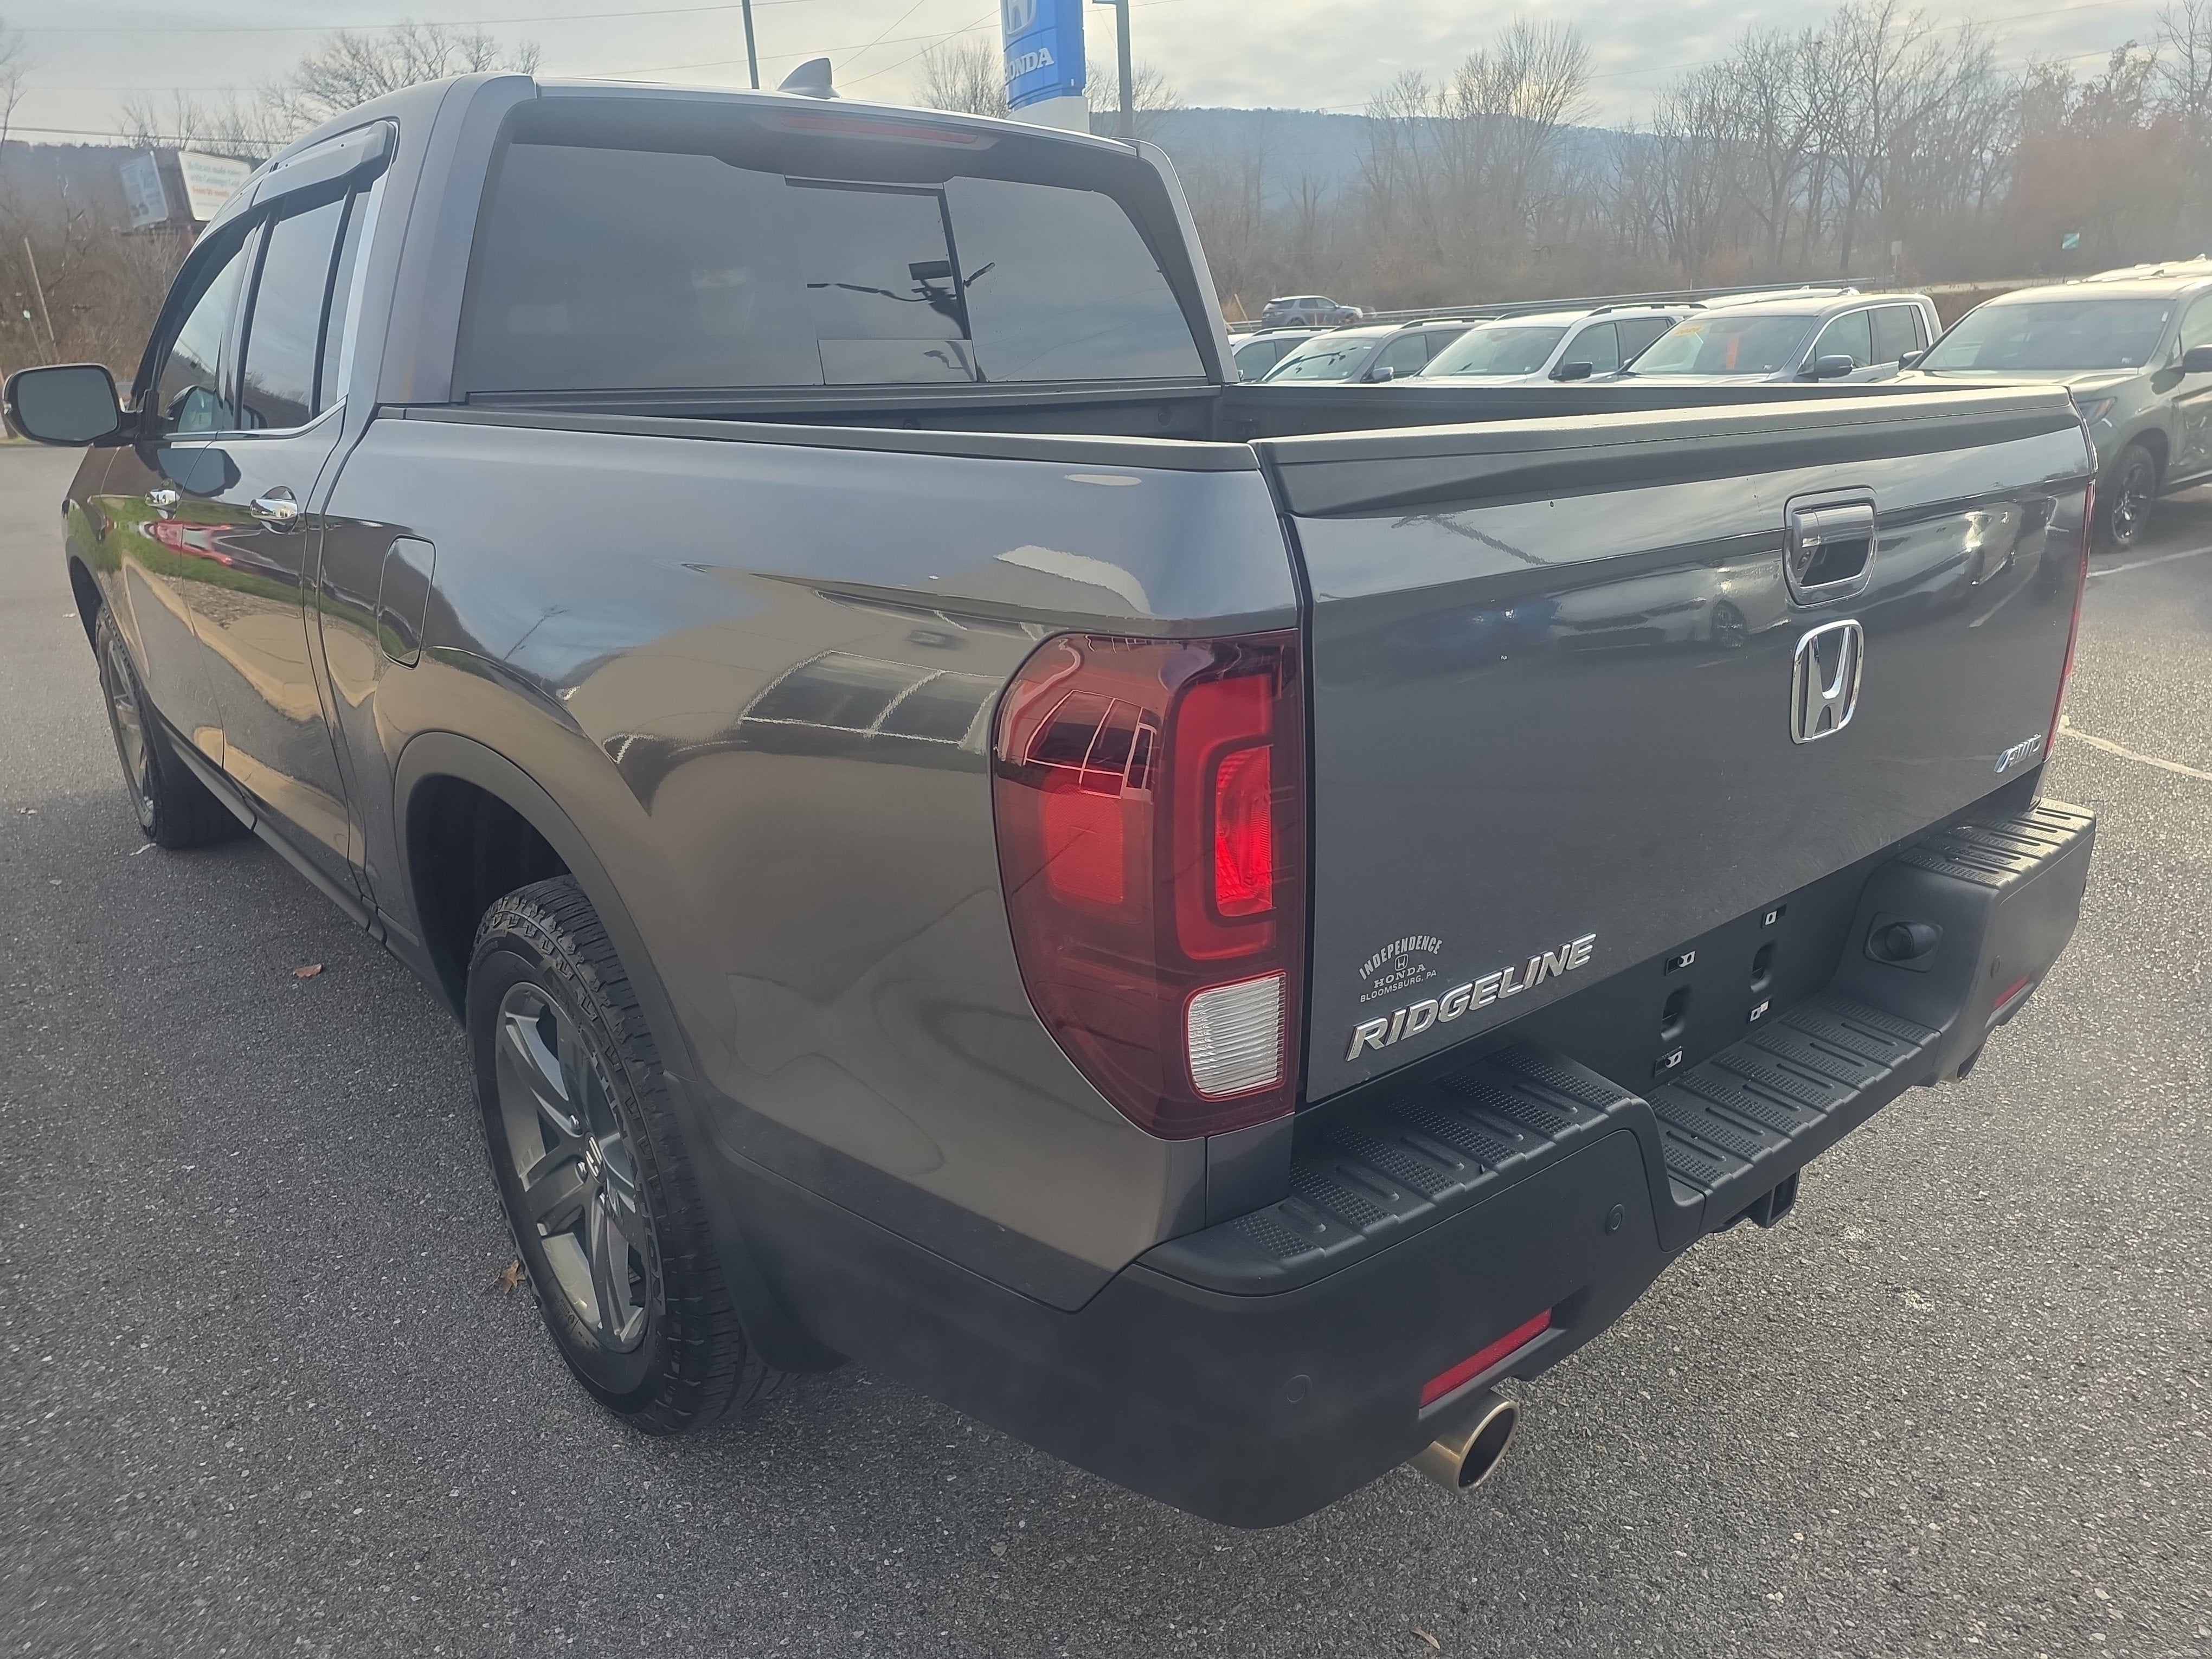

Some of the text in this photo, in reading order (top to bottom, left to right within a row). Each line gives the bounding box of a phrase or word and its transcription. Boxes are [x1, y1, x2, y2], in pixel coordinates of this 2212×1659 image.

[1359, 935, 1443, 980] INDEPENDENCE
[1374, 963, 1426, 988] HONDA
[1345, 933, 1597, 1062] RIDGELINE
[1360, 969, 1437, 1003] BLOOMSBURG, PA
